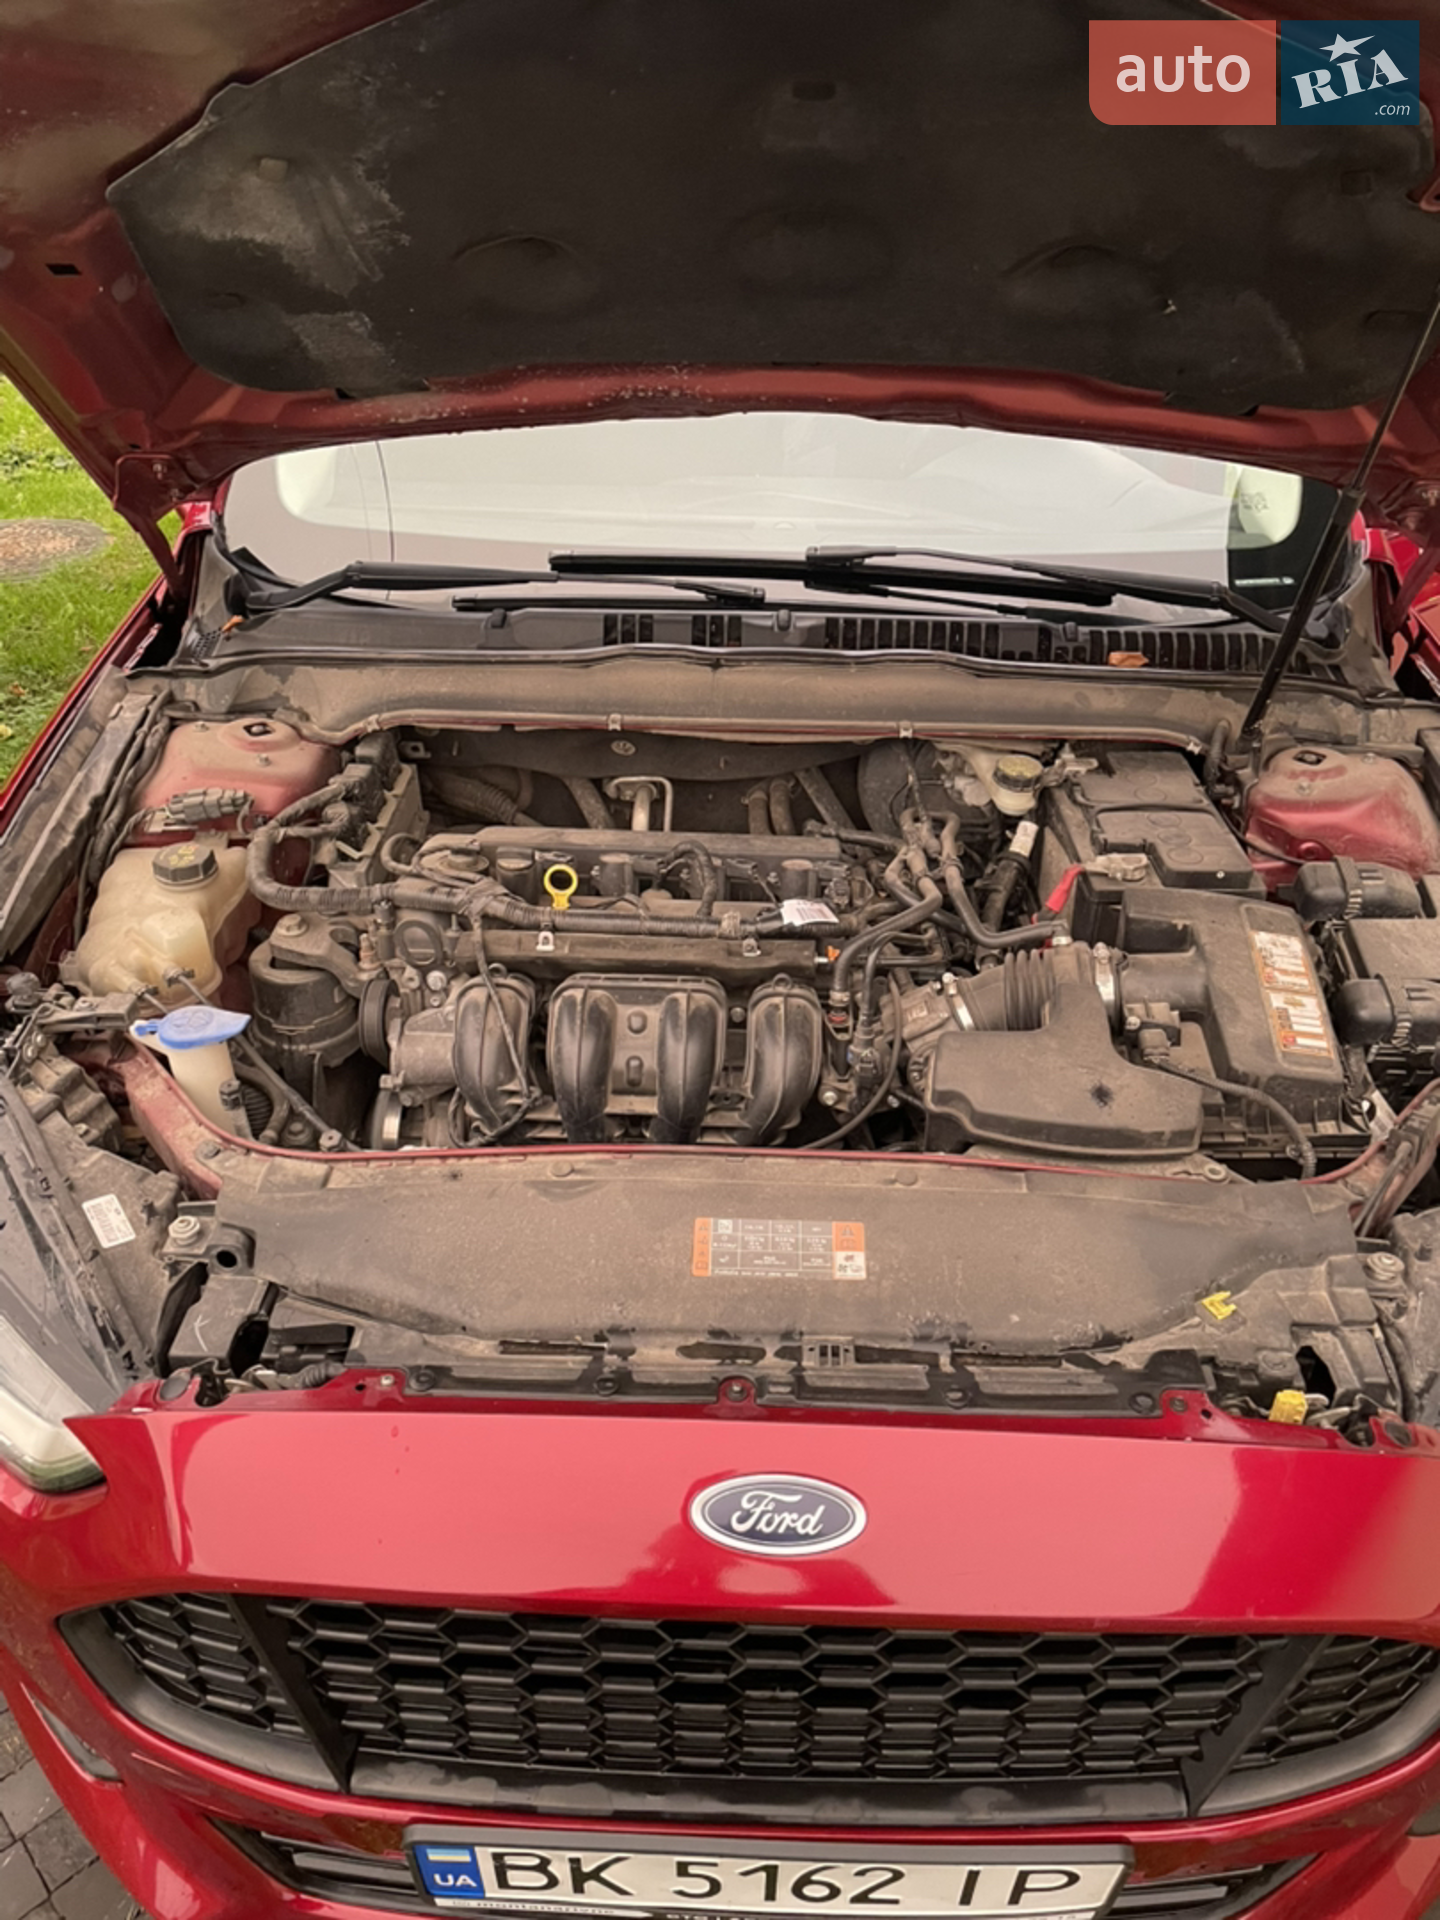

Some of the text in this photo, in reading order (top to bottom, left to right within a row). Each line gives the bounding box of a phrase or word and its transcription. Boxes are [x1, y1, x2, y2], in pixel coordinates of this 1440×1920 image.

[730, 1490, 826, 1536] Ford
[434, 1874, 477, 1888] UA
[491, 1852, 635, 1897] BK
[672, 1859, 906, 1905] 5162
